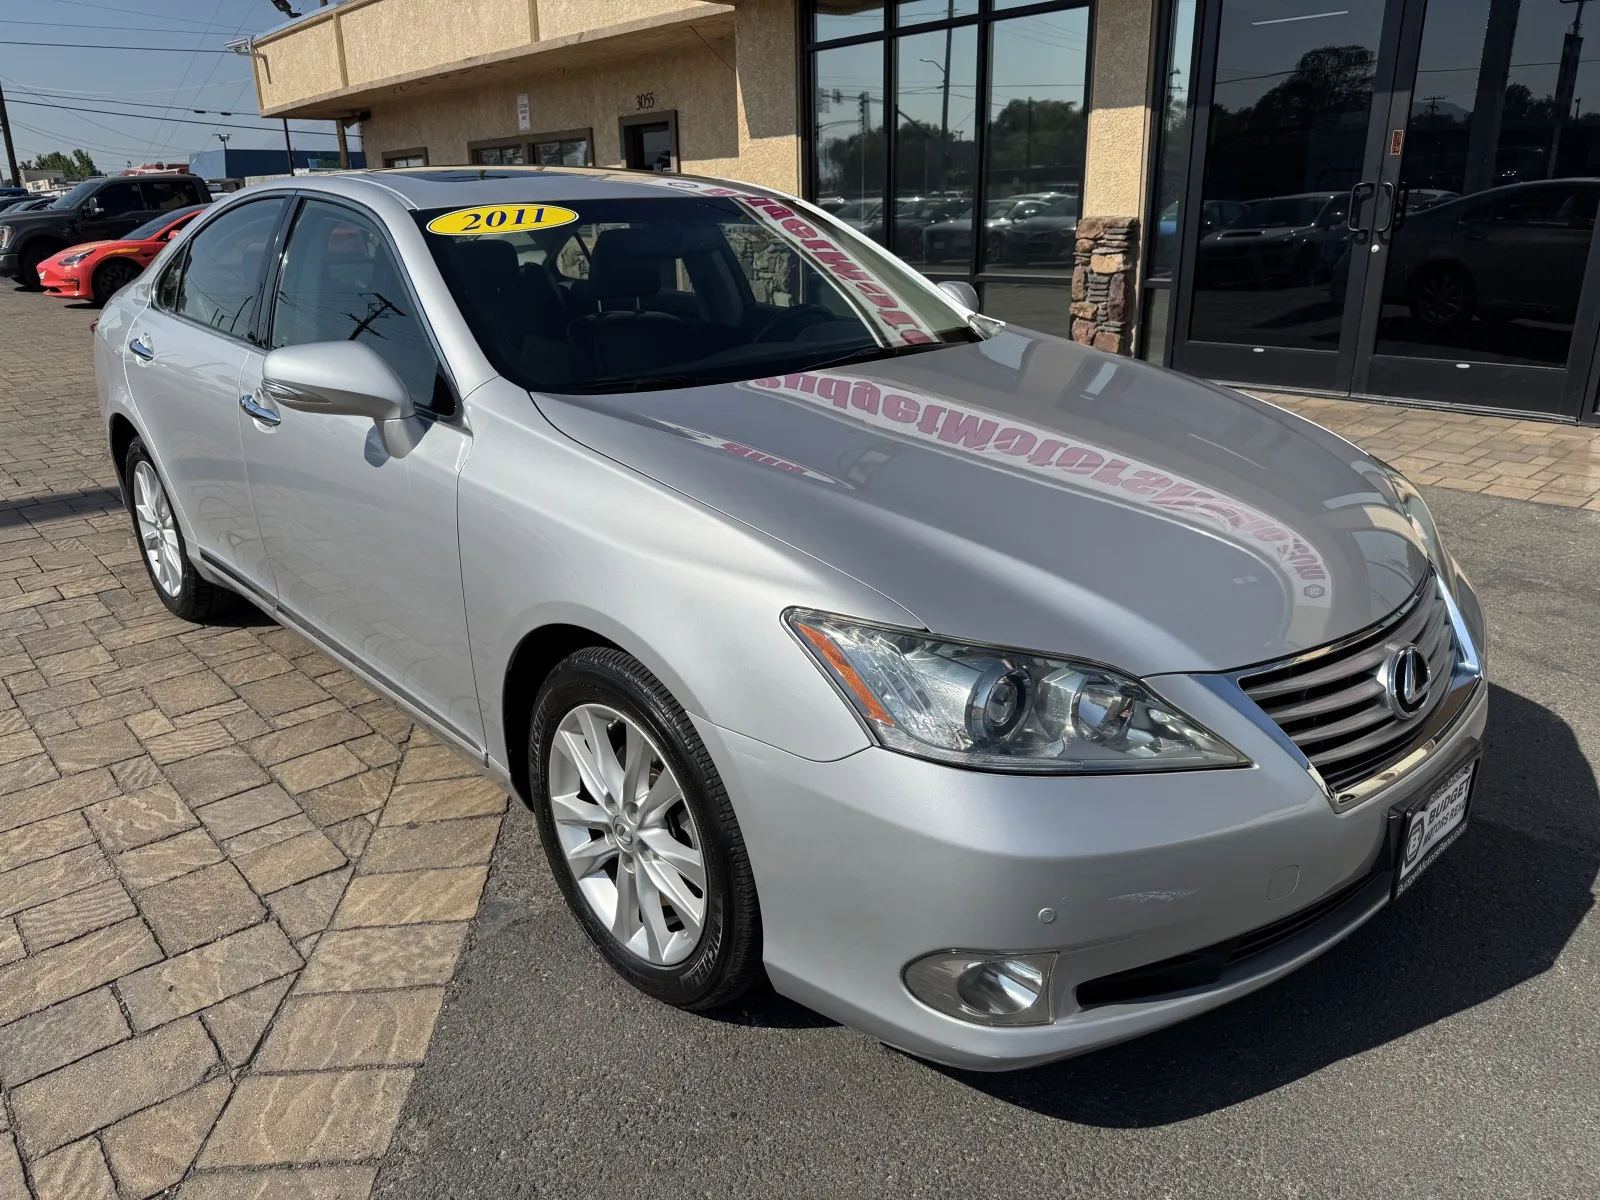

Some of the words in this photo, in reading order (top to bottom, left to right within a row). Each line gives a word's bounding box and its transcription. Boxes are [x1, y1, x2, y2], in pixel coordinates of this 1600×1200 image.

[635, 91, 655, 110] 3055
[461, 207, 545, 231] 2011
[1428, 778, 1470, 826] BUDGET
[1423, 811, 1451, 847] MOTORS
